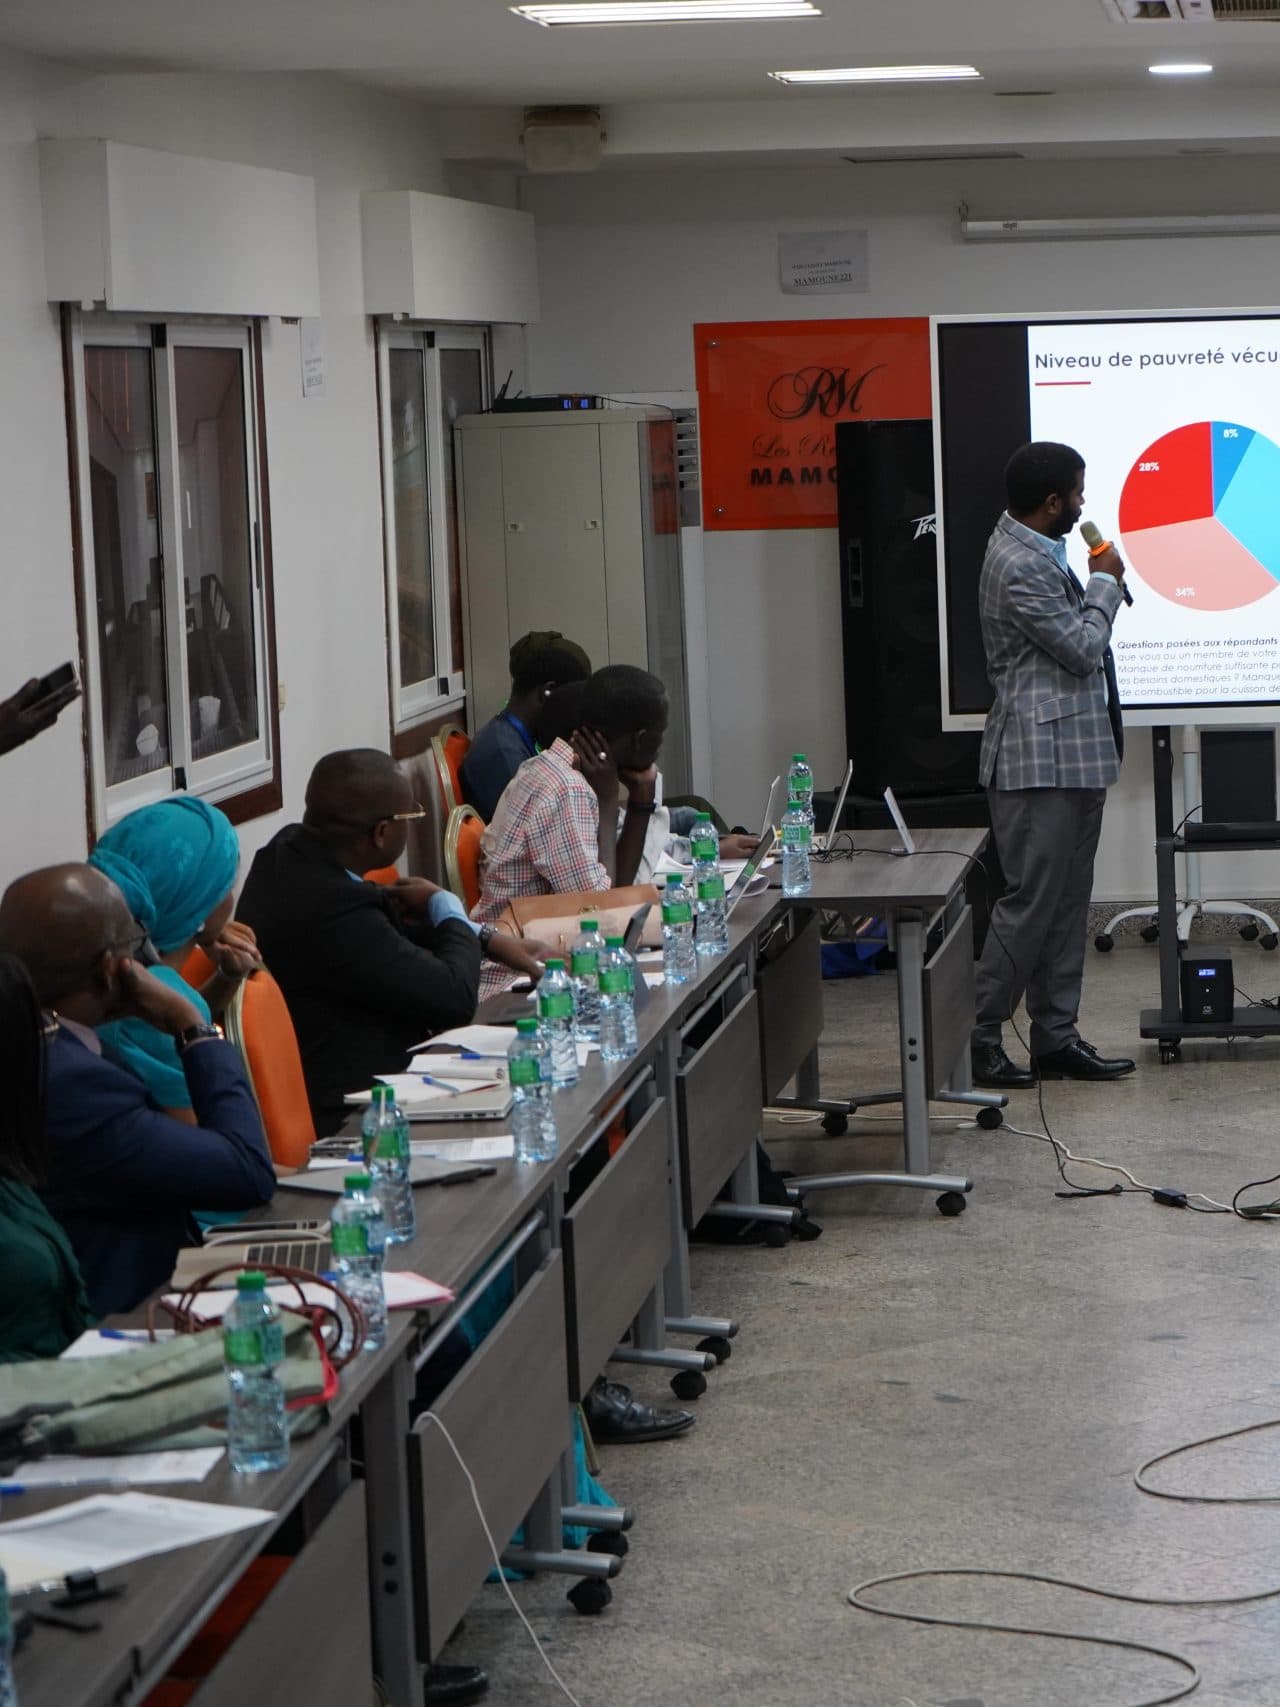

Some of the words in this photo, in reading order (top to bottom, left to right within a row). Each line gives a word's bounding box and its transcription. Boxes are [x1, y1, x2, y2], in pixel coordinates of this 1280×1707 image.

[1035, 353, 1101, 368] Niveau
[1108, 352, 1133, 366] de
[1140, 347, 1225, 369] pauvreté
[767, 364, 888, 420] RM
[1223, 429, 1239, 438] 8%
[1139, 462, 1160, 472] 28%
[751, 467, 838, 486] MAMO
[1175, 587, 1196, 597] 34%
[1117, 641, 1164, 649] Questions
[1166, 639, 1200, 650] posées
[1223, 637, 1278, 648] répondants
[1118, 654, 1136, 662] que
[1193, 650, 1233, 659] membre
[1236, 649, 1250, 658] de
[1253, 649, 1277, 657] votre
[1118, 664, 1159, 673] Manque
[1161, 664, 1174, 672] de
[1177, 663, 1222, 671] nourriture
[1225, 661, 1268, 670] suffisante
[1118, 676, 1131, 684] les
[1134, 676, 1168, 684] besoins
[1170, 674, 1232, 683] domestiques
[1119, 688, 1132, 696] de
[1134, 686, 1193, 696] combustible
[1195, 686, 1218, 695] pour
[1220, 684, 1229, 693] la
[1231, 685, 1266, 693] cuisson
